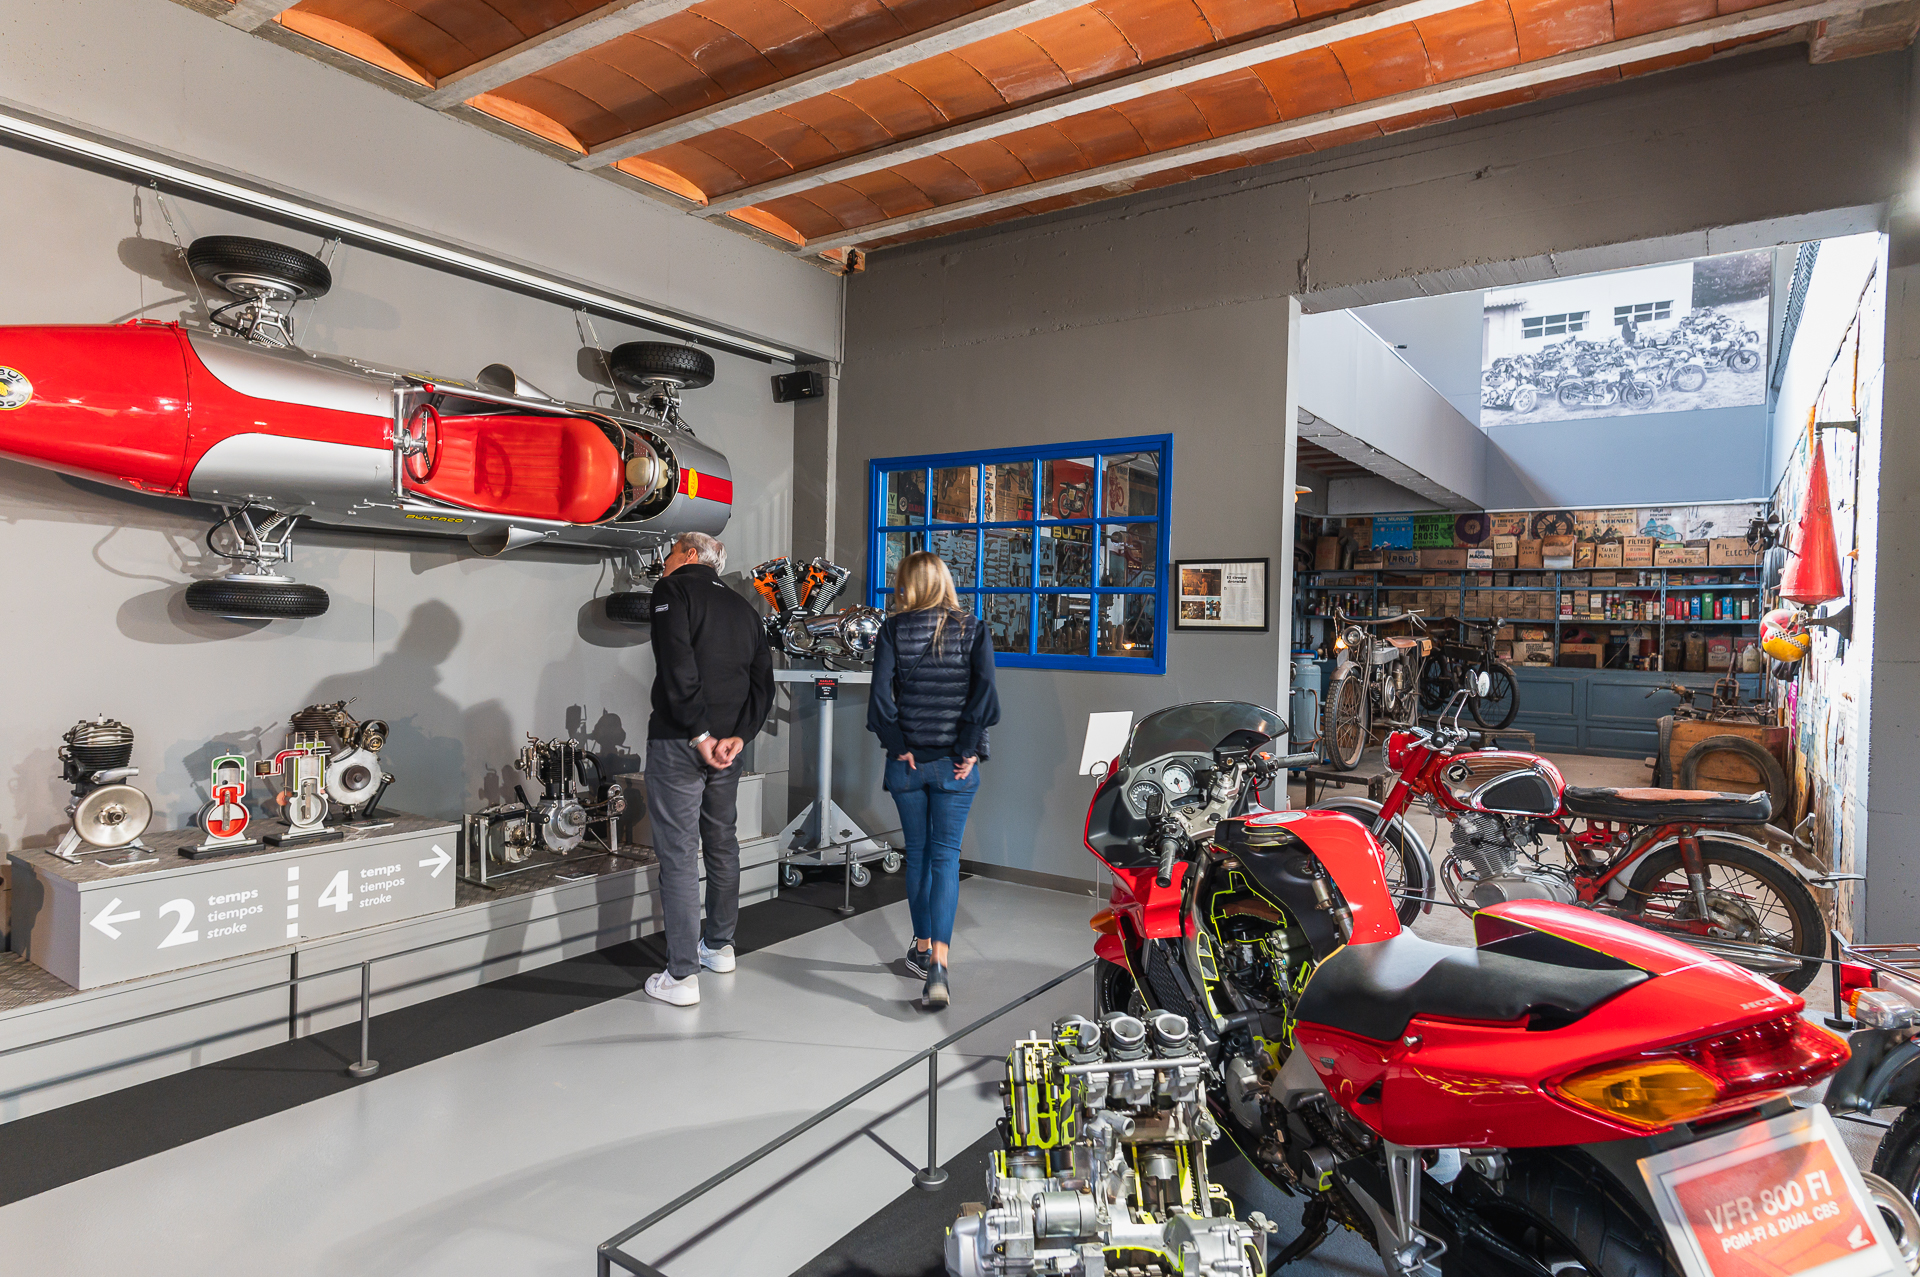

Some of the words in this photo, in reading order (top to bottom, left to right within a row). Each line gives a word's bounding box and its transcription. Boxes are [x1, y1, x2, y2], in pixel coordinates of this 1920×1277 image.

[405, 514, 464, 523] BULTACO
[1413, 532, 1439, 540] CROSS
[1418, 524, 1439, 532] MOTO
[360, 863, 402, 879] temps
[317, 869, 354, 913] 4
[360, 878, 405, 893] tiempos
[207, 889, 259, 906] temps
[359, 893, 392, 908] stroke
[207, 904, 264, 923] tiempos
[156, 898, 199, 950] 2
[206, 922, 248, 939] stroke
[1740, 992, 1796, 1011] HON
[1704, 1195, 1759, 1235] VFR
[1759, 1180, 1805, 1216] 800
[1804, 1169, 1833, 1201] FI
[1720, 1224, 1768, 1255] PGM-FI
[1766, 1221, 1780, 1238] &
[1777, 1209, 1815, 1234] DUAL
[1811, 1200, 1841, 1221] CBS
